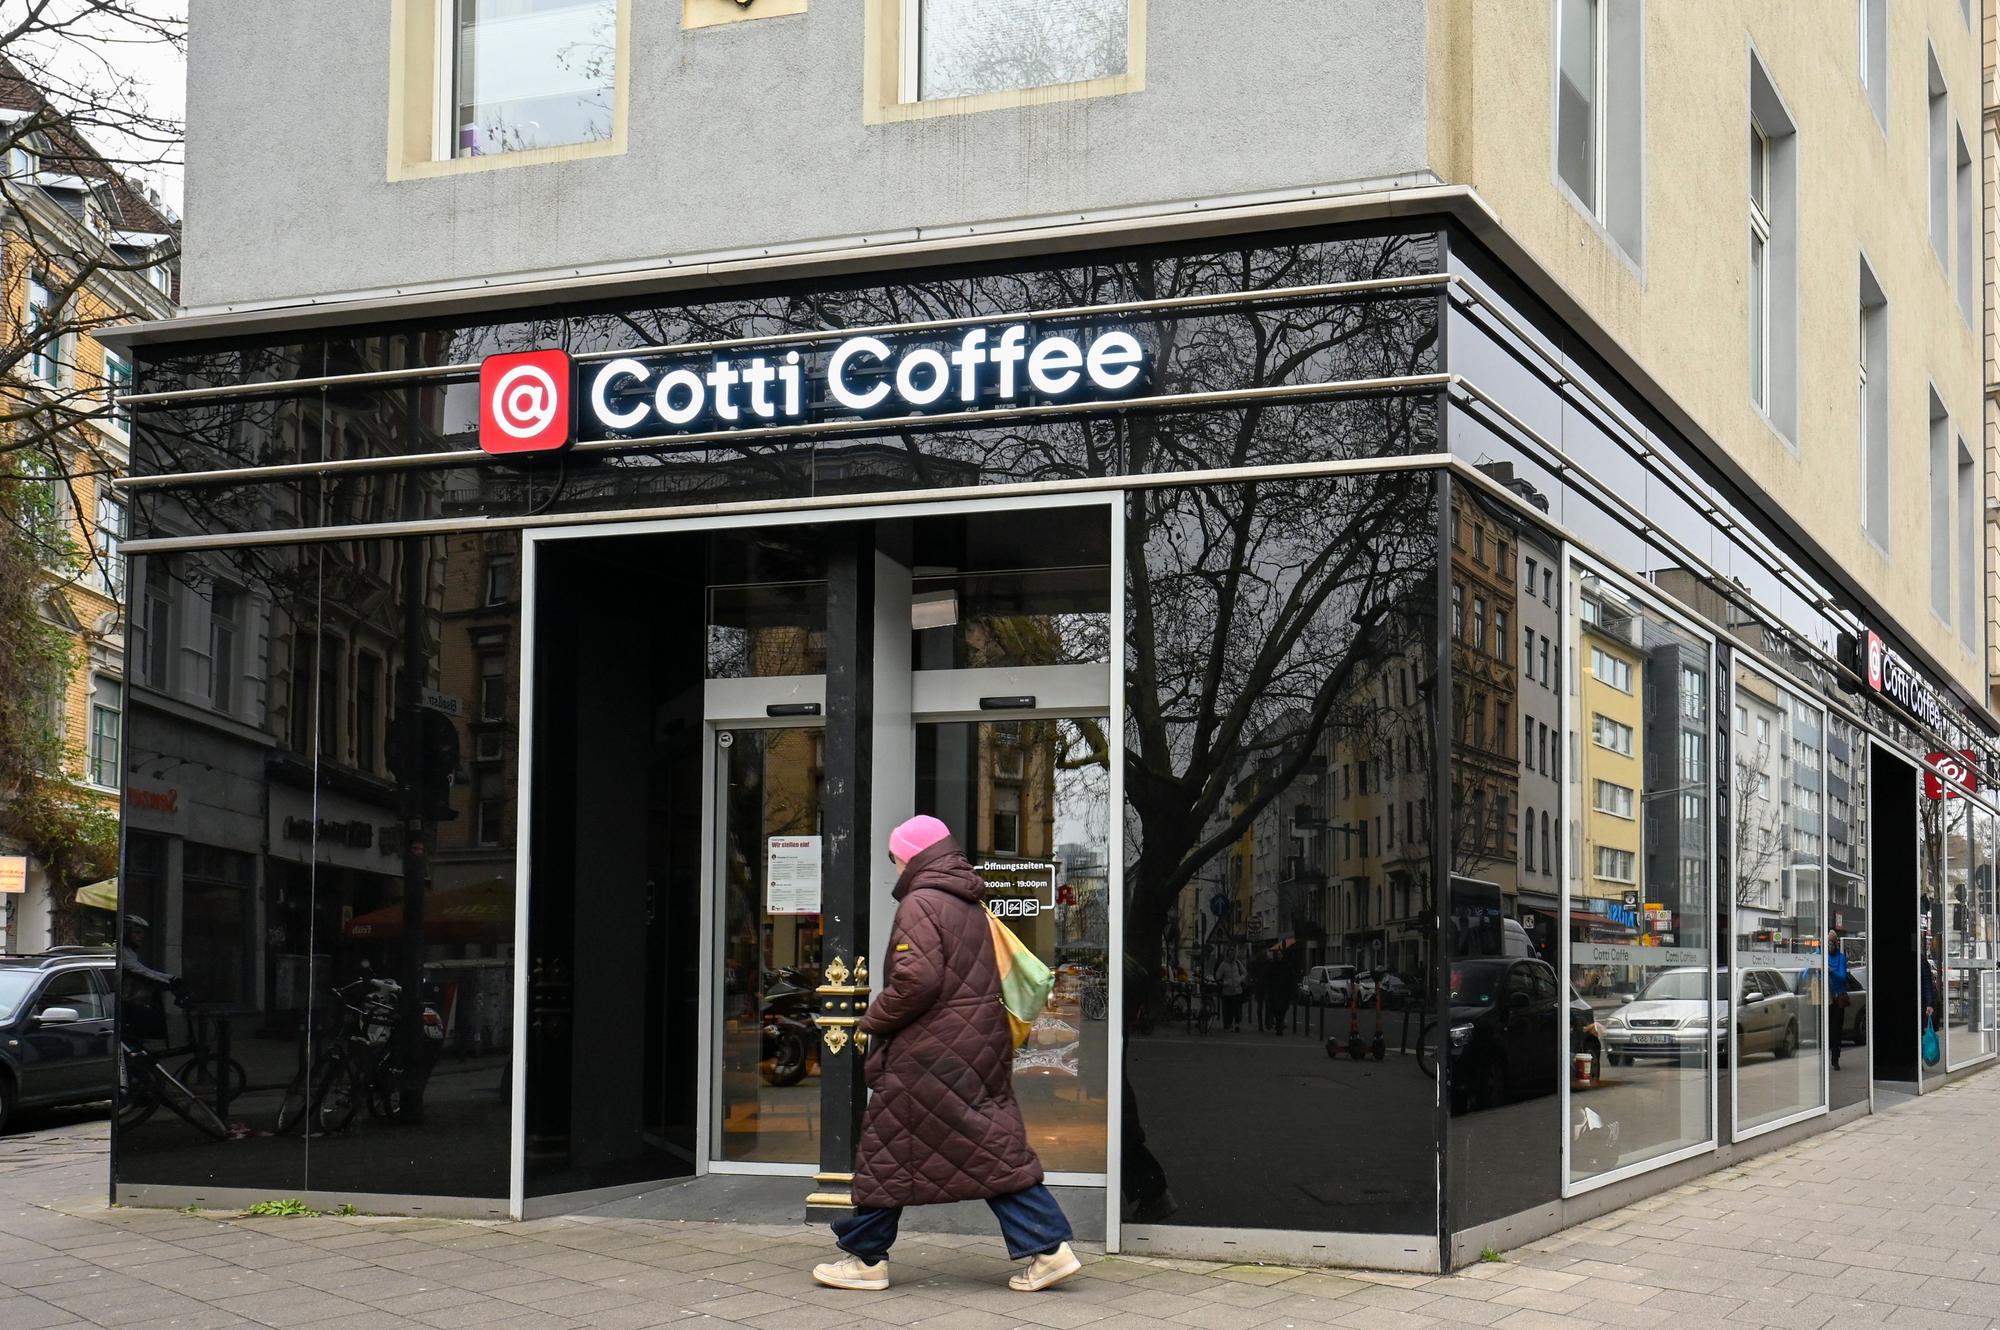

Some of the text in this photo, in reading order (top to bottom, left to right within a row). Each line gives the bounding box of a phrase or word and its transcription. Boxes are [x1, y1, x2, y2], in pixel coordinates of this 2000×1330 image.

[591, 351, 800, 429] Cotti
[828, 325, 1143, 410] Coffee
[1883, 655, 1910, 707] Cotti
[1911, 678, 1941, 730] Coffee
[984, 861, 1044, 872] Öffnungszeiten
[1017, 880, 1048, 888] 19:00pm
[1593, 947, 1610, 961] Cotti
